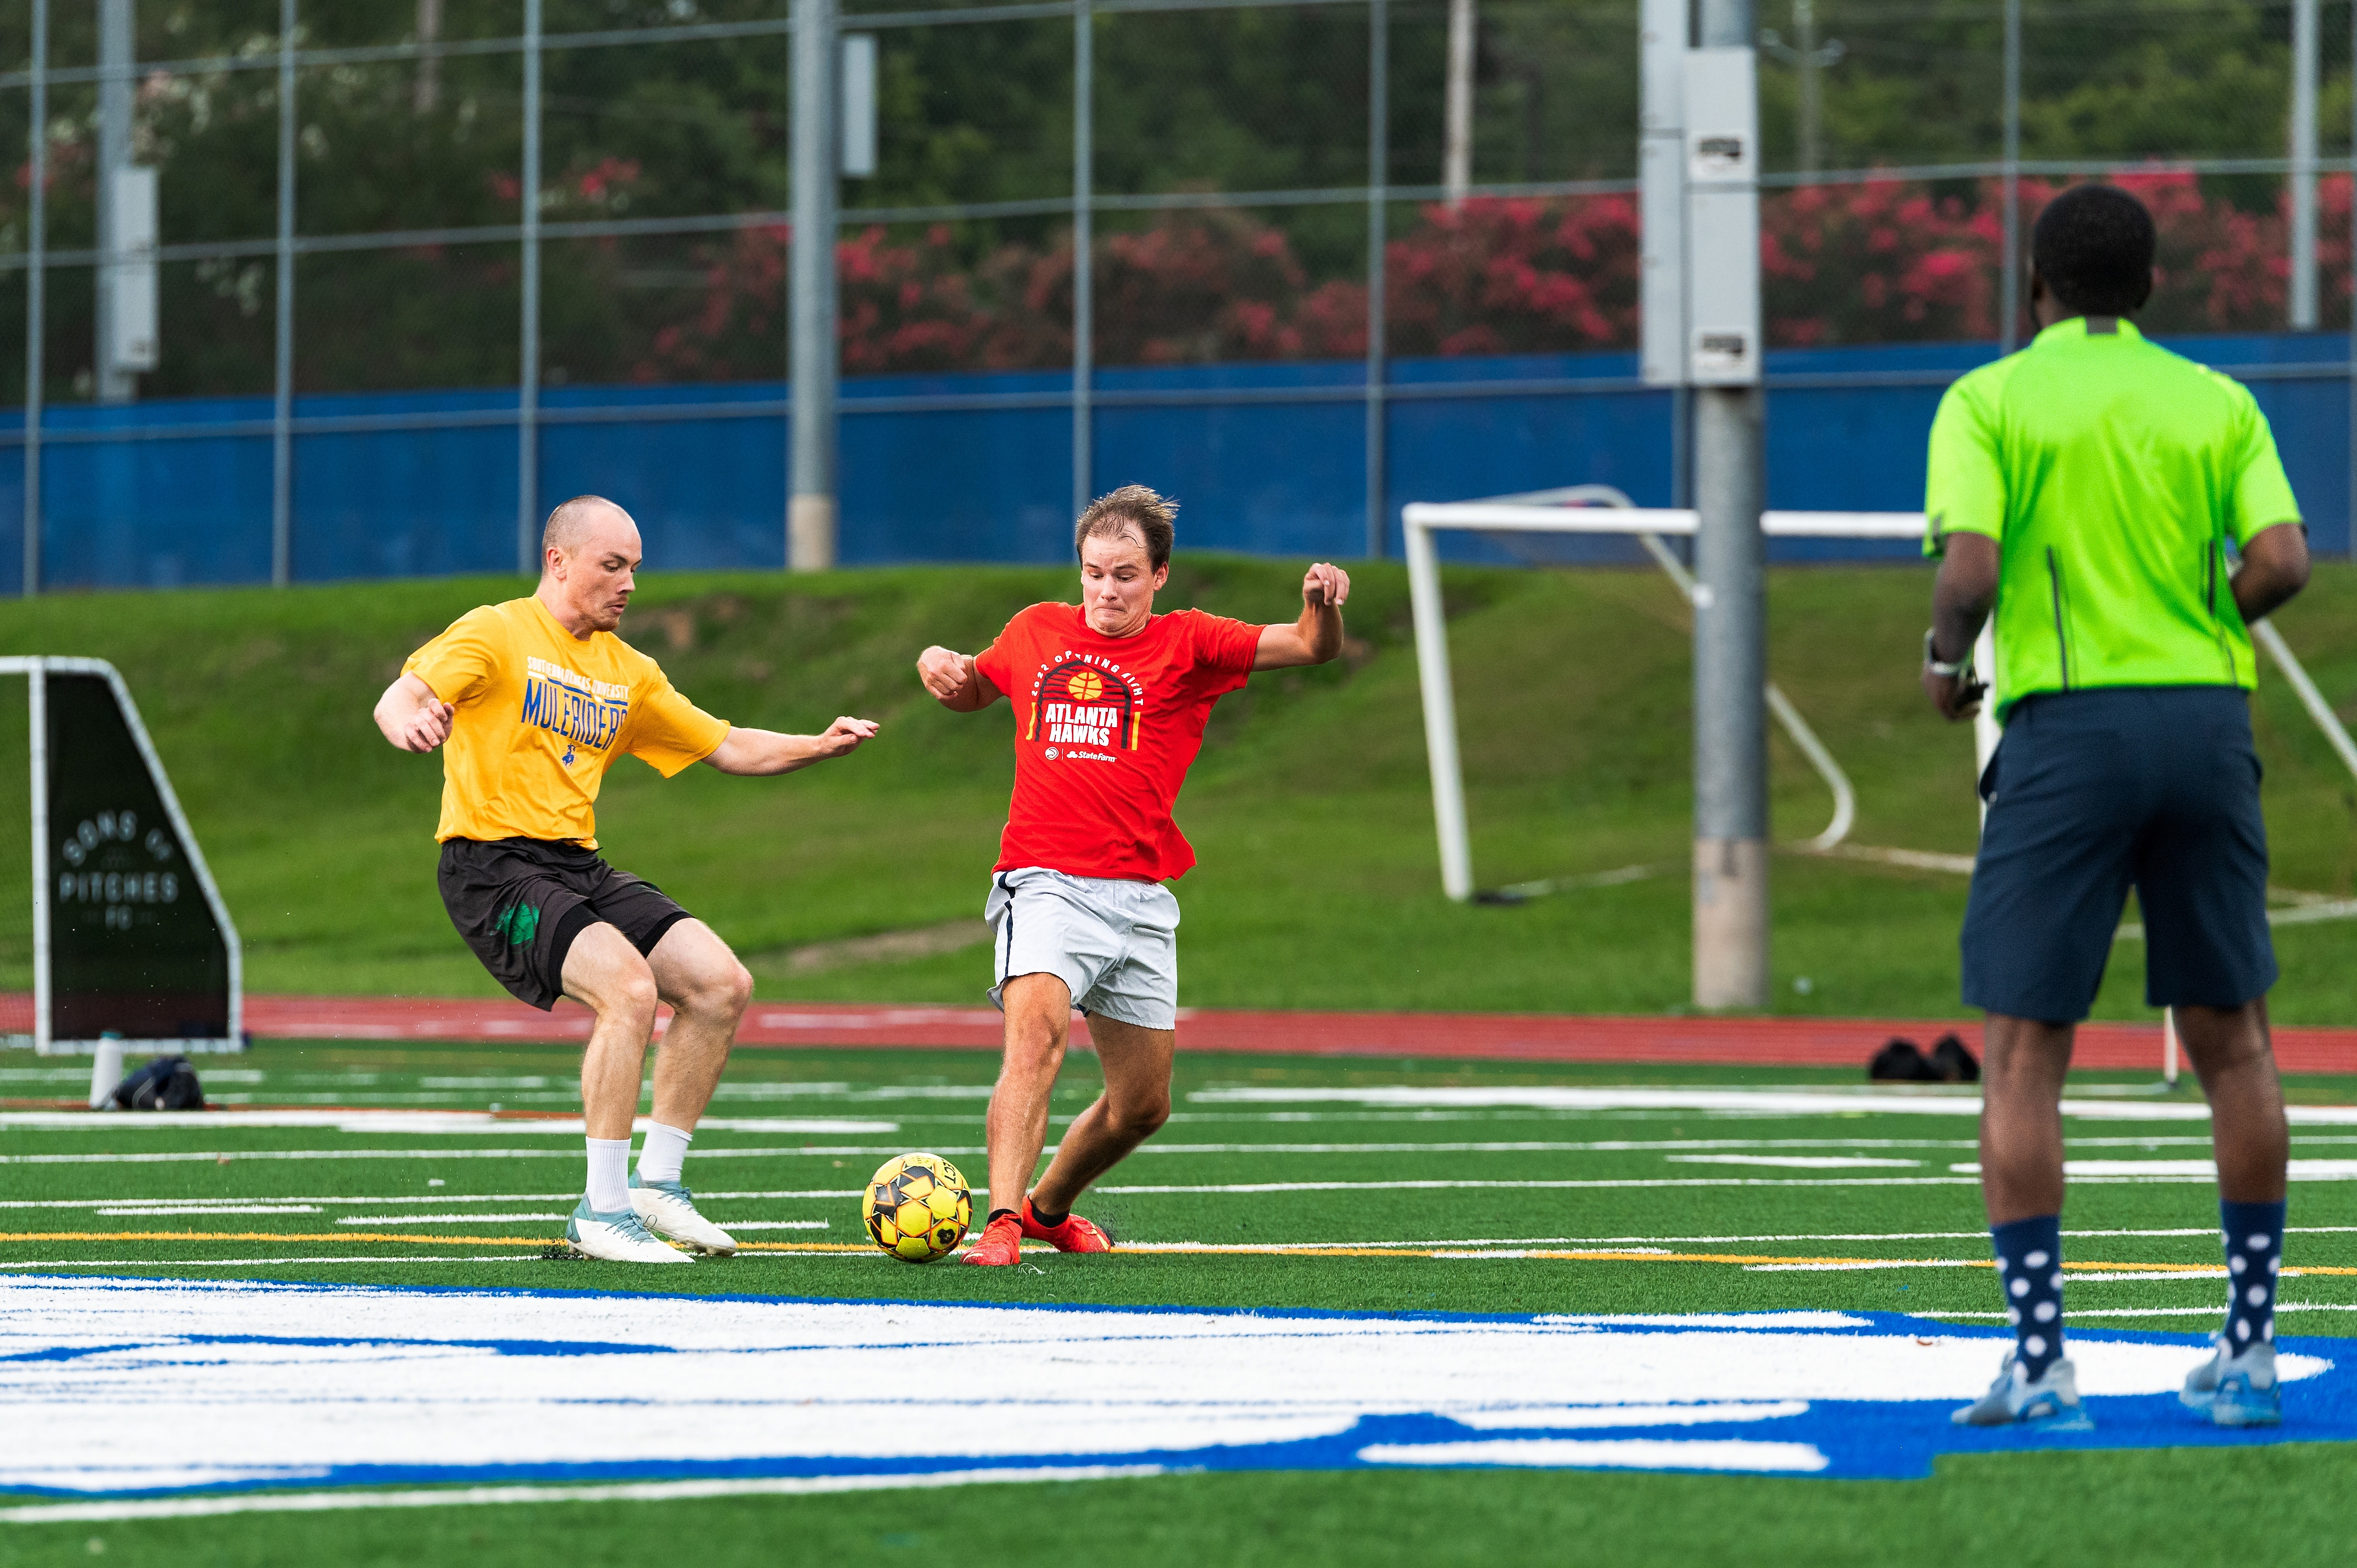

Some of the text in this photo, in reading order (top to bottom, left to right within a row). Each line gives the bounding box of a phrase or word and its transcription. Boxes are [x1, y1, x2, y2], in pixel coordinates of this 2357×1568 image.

[592, 680, 629, 699] UNIVERSTY
[1031, 663, 1050, 696] 2022
[1045, 704, 1118, 728] ATLANTA
[1049, 723, 1110, 746] HAWKS
[62, 808, 174, 868] SONS OF
[59, 871, 179, 903] PITCHES
[941, 1158, 956, 1184] ECT
